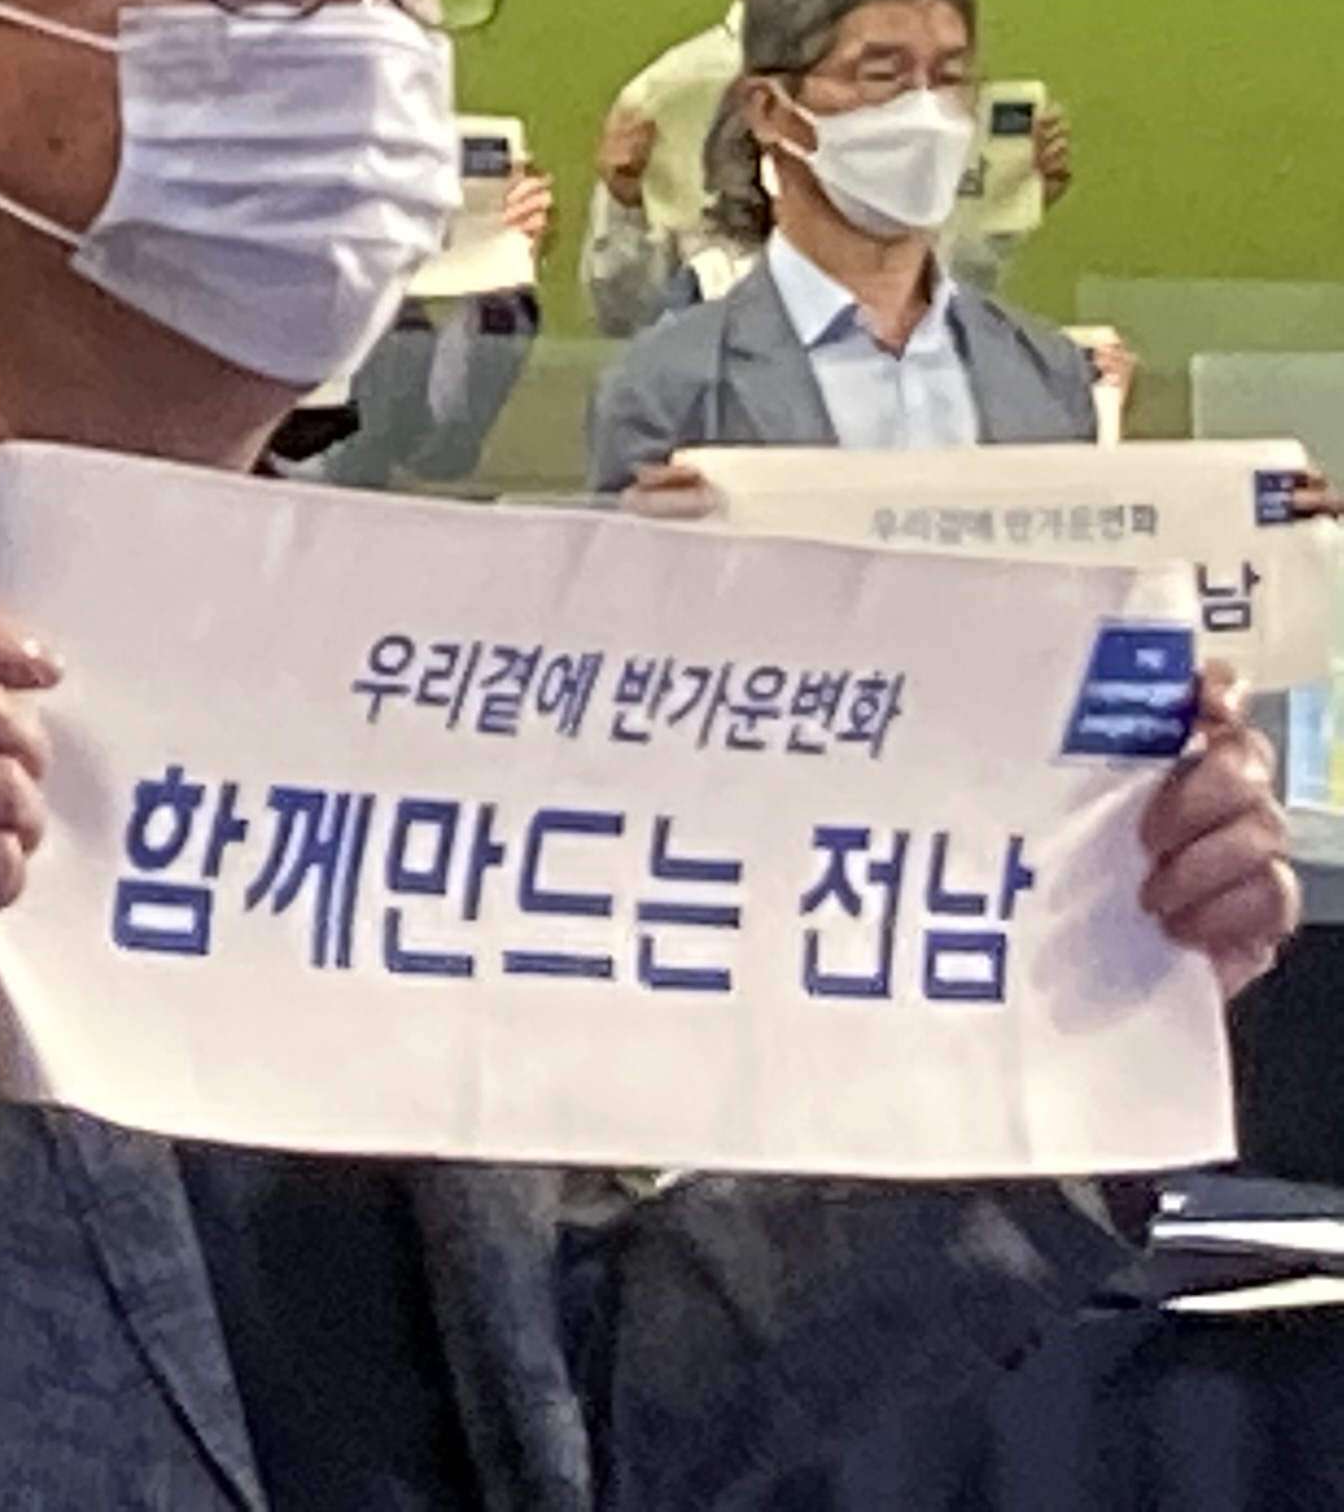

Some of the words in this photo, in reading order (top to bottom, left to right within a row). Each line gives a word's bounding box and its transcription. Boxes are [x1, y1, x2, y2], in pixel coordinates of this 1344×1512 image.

[1196, 561, 1262, 633] 남
[352, 633, 598, 739] 우리곁에
[610, 657, 908, 760] 반가운변화
[112, 765, 745, 994] 함께만드는
[799, 825, 1036, 1003] 전남
